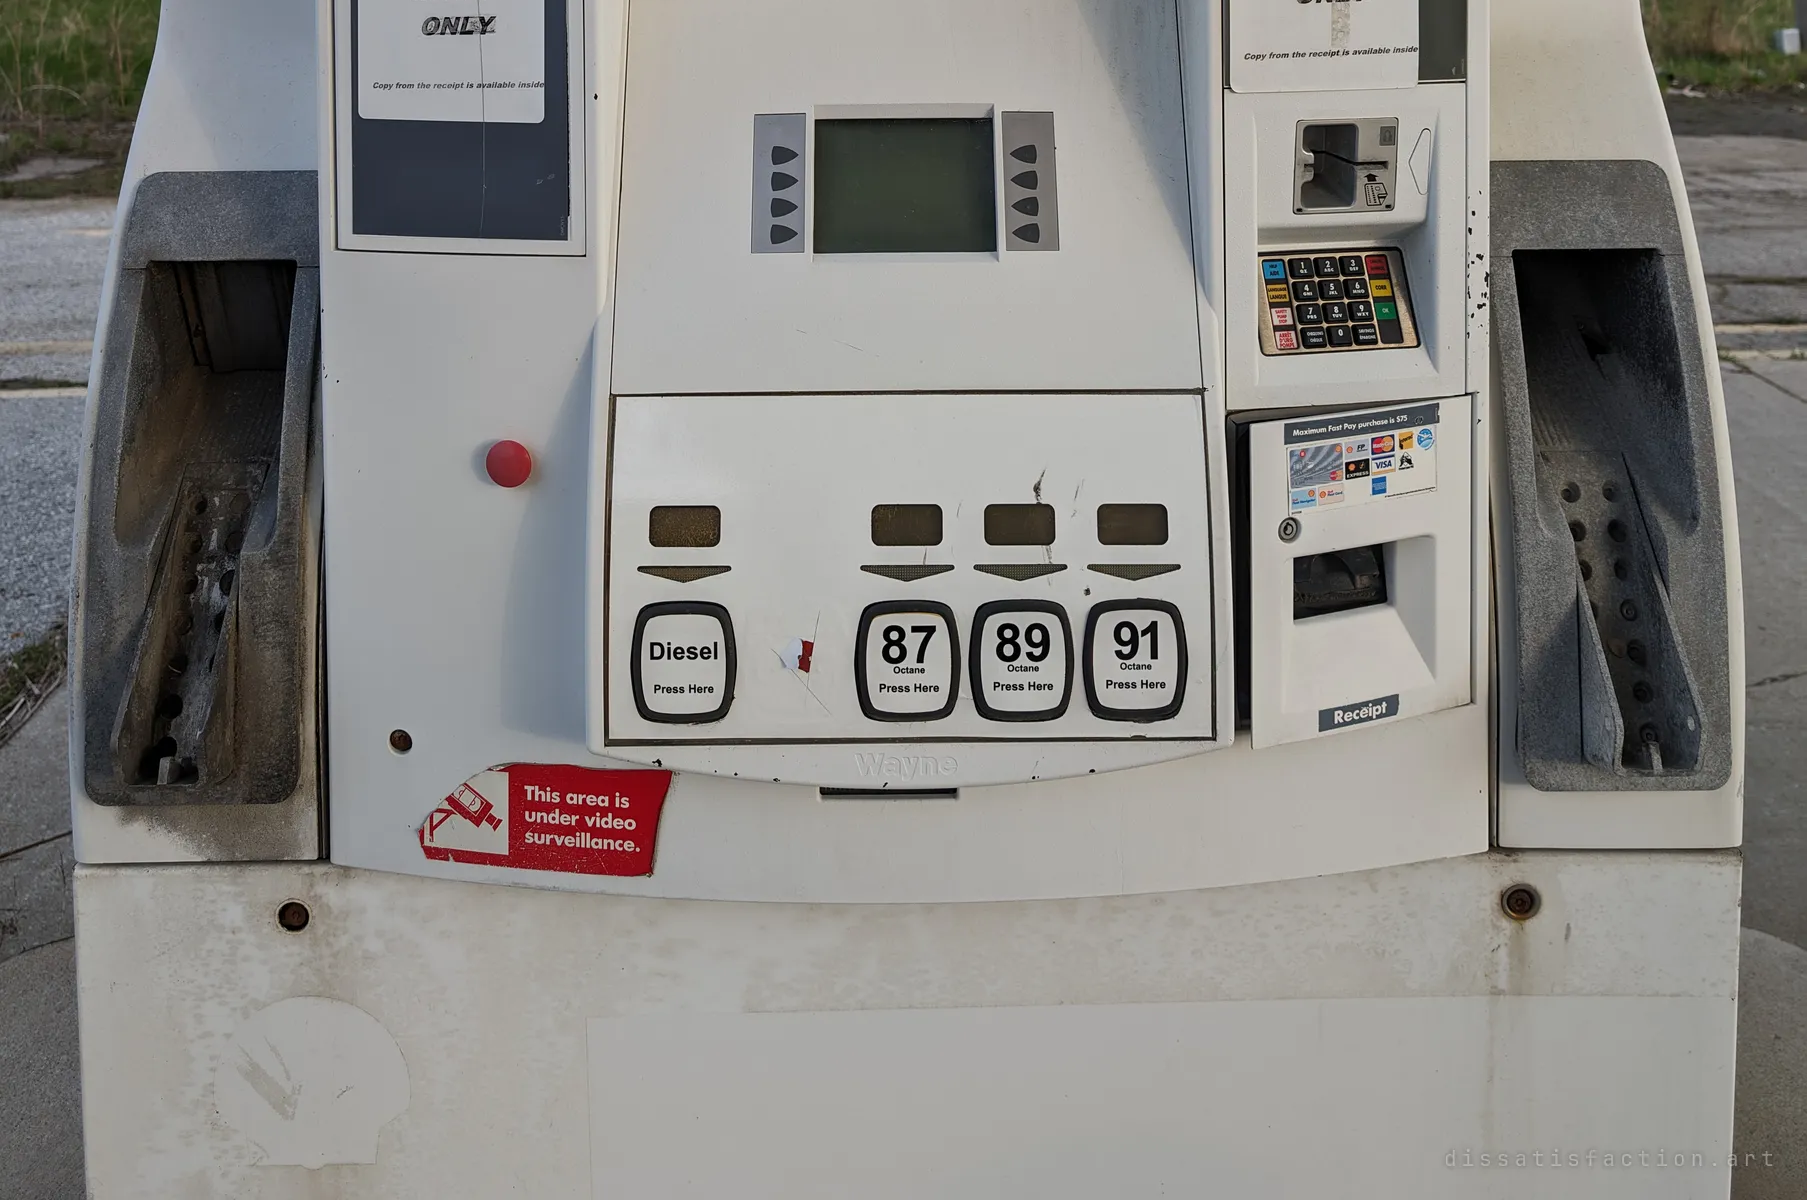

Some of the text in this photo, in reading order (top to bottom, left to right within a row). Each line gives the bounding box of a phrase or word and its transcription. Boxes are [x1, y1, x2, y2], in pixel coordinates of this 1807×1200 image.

[421, 16, 496, 36] ONLY
[1244, 52, 1266, 61] Copy
[1269, 51, 1290, 59] from
[1292, 50, 1307, 58] the
[1308, 49, 1340, 58] receipt
[1352, 46, 1391, 55] available
[1392, 46, 1419, 54] inside
[372, 80, 545, 91] Copy from the receipt is available inside
[1293, 428, 1327, 436] Maximum
[1328, 424, 1342, 432] Fast
[1343, 423, 1356, 432] Pay
[1358, 419, 1388, 430] purchase
[1396, 415, 1407, 423] $75
[1375, 461, 1392, 469] VISA
[881, 625, 937, 664] 87
[995, 622, 1051, 662] 89
[1113, 620, 1160, 660] 91
[649, 641, 719, 662] Diesel
[893, 665, 926, 674] Octane
[1006, 663, 1040, 673] Octane
[1119, 662, 1152, 671] Octane
[653, 683, 714, 694] Press Here
[878, 683, 940, 693] Press Here
[992, 681, 1053, 691] Press Here
[1105, 679, 1166, 689] Press Here
[1334, 702, 1388, 724] Receipt
[856, 752, 958, 781] Wayne
[524, 785, 629, 808] This area is
[524, 810, 636, 830] under video
[524, 830, 641, 852] surveillance.
